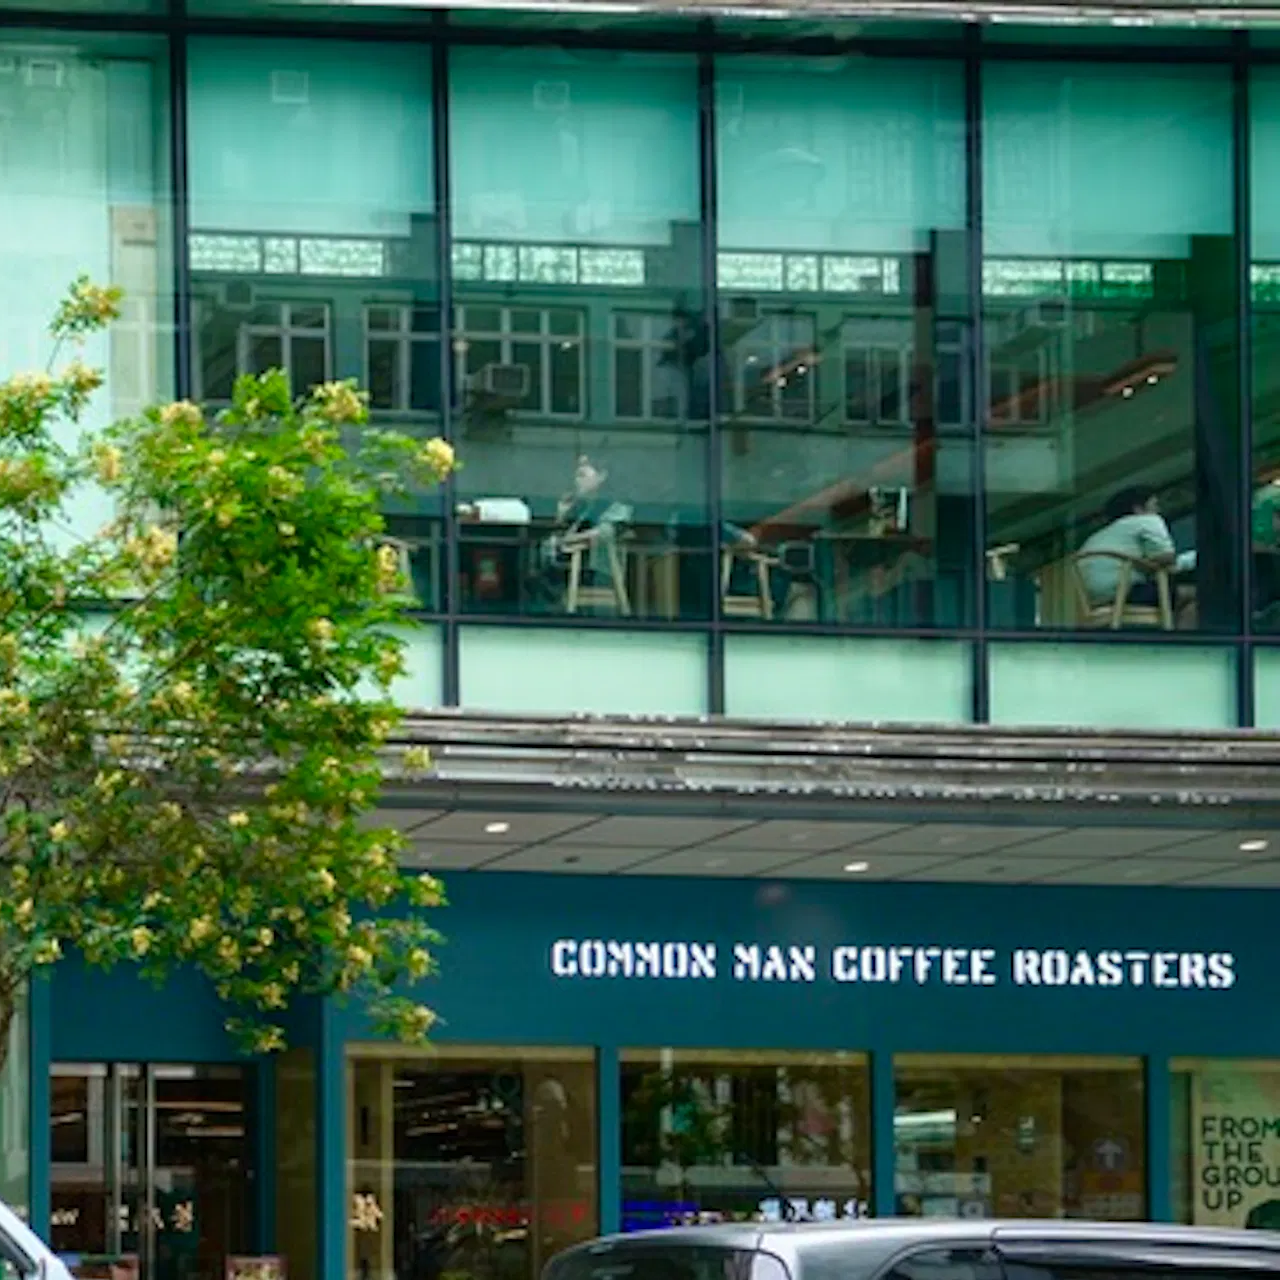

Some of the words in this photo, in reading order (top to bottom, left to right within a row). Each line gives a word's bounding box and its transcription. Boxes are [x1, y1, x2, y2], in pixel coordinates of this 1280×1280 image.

[551, 939, 717, 979] COMMON
[733, 944, 817, 982] MAN
[831, 946, 996, 985] COFFEE
[1013, 950, 1236, 989] ROASTERS
[1202, 1141, 1263, 1163] THE
[1202, 1189, 1244, 1212] UP
